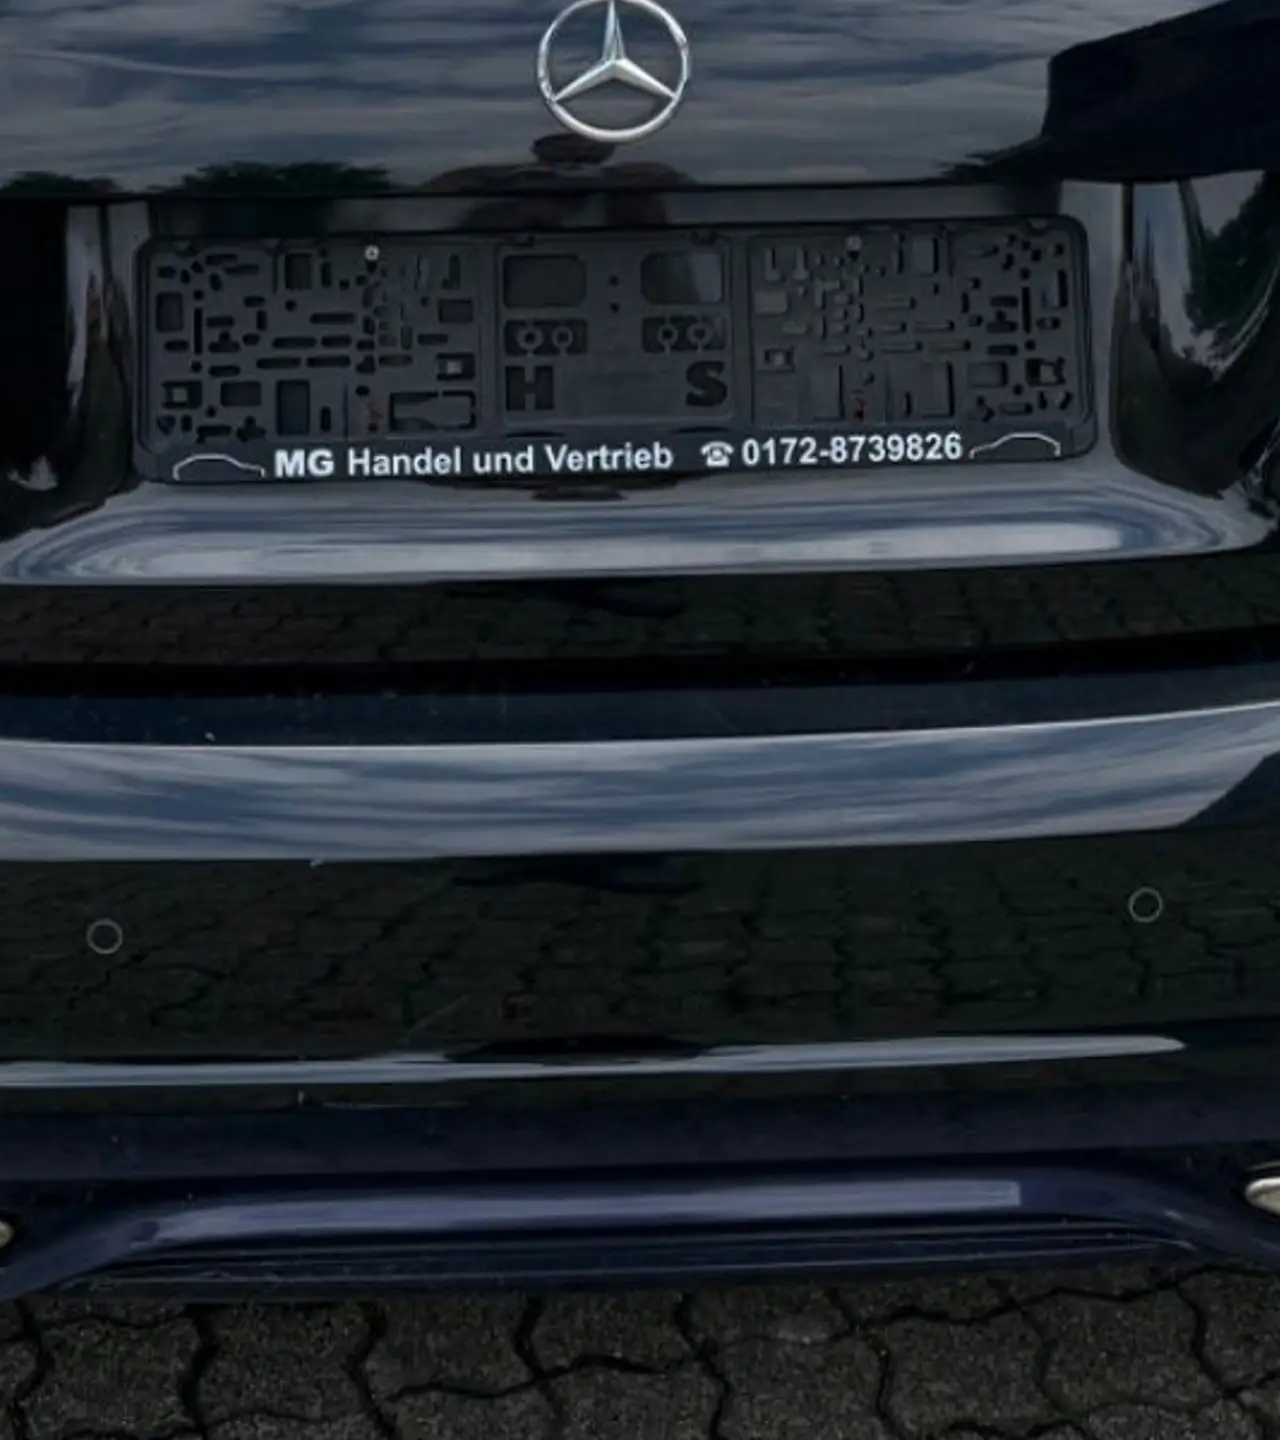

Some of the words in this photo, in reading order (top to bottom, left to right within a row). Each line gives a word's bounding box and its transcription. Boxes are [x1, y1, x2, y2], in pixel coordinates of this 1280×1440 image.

[274, 449, 334, 478] MG
[348, 447, 462, 476] Handel
[472, 445, 534, 473] und
[544, 441, 674, 471] Vertrieb
[742, 432, 963, 466] 0172-8739826
